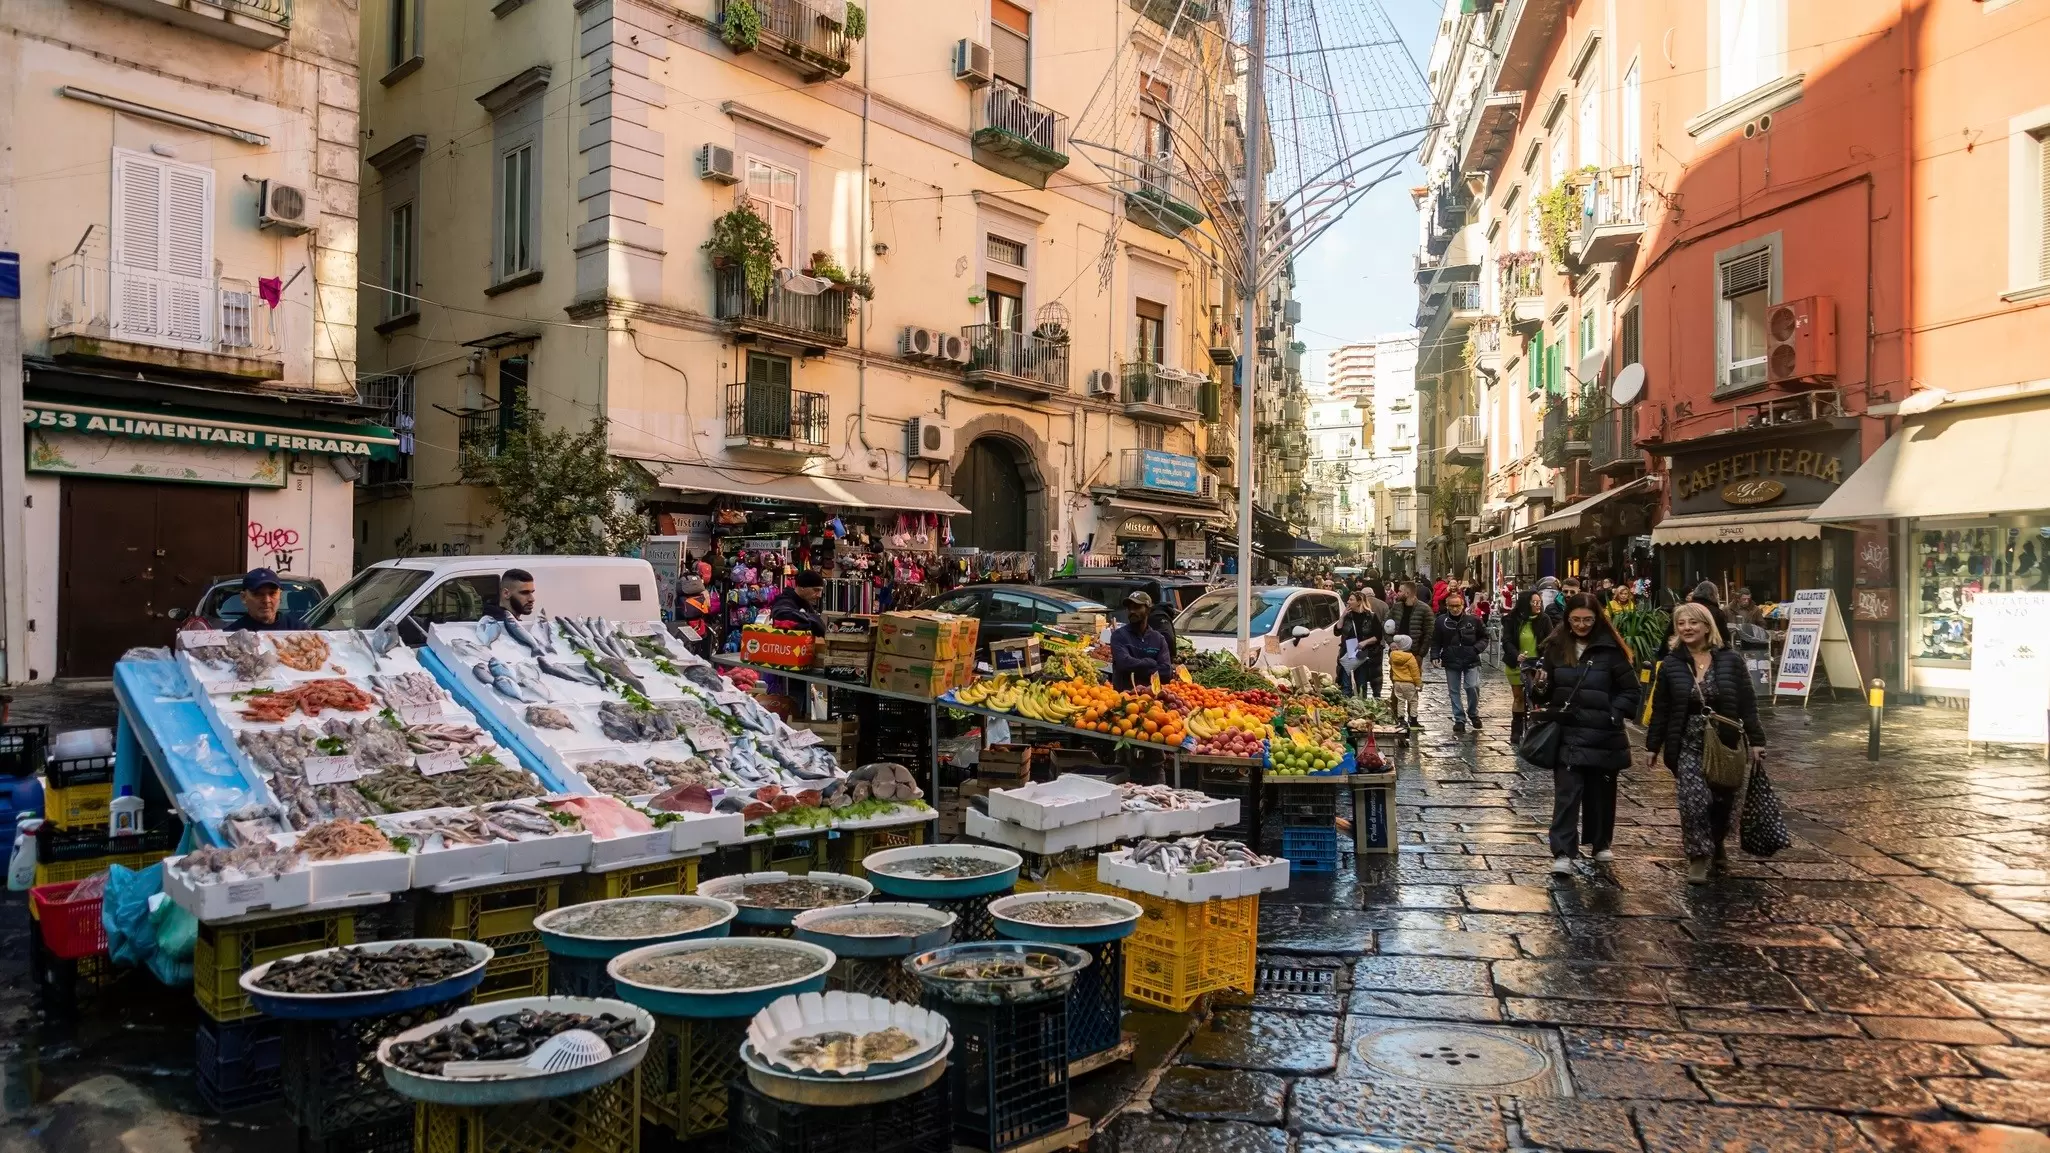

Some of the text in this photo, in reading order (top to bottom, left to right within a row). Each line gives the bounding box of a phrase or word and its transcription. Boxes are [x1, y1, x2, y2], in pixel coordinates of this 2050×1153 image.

[86, 416, 255, 445] ALIMENTARI
[265, 433, 372, 456] FERRARA
[1677, 449, 1842, 500] CAFFETTERIA
[1125, 522, 1158, 533] Mister X
[1796, 592, 1827, 600] CALZATURE
[1792, 634, 1812, 645] UOMO
[761, 643, 792, 656] CITRUS
[1788, 649, 1810, 659] DONNA
[1783, 663, 1809, 673] BAMBINO
